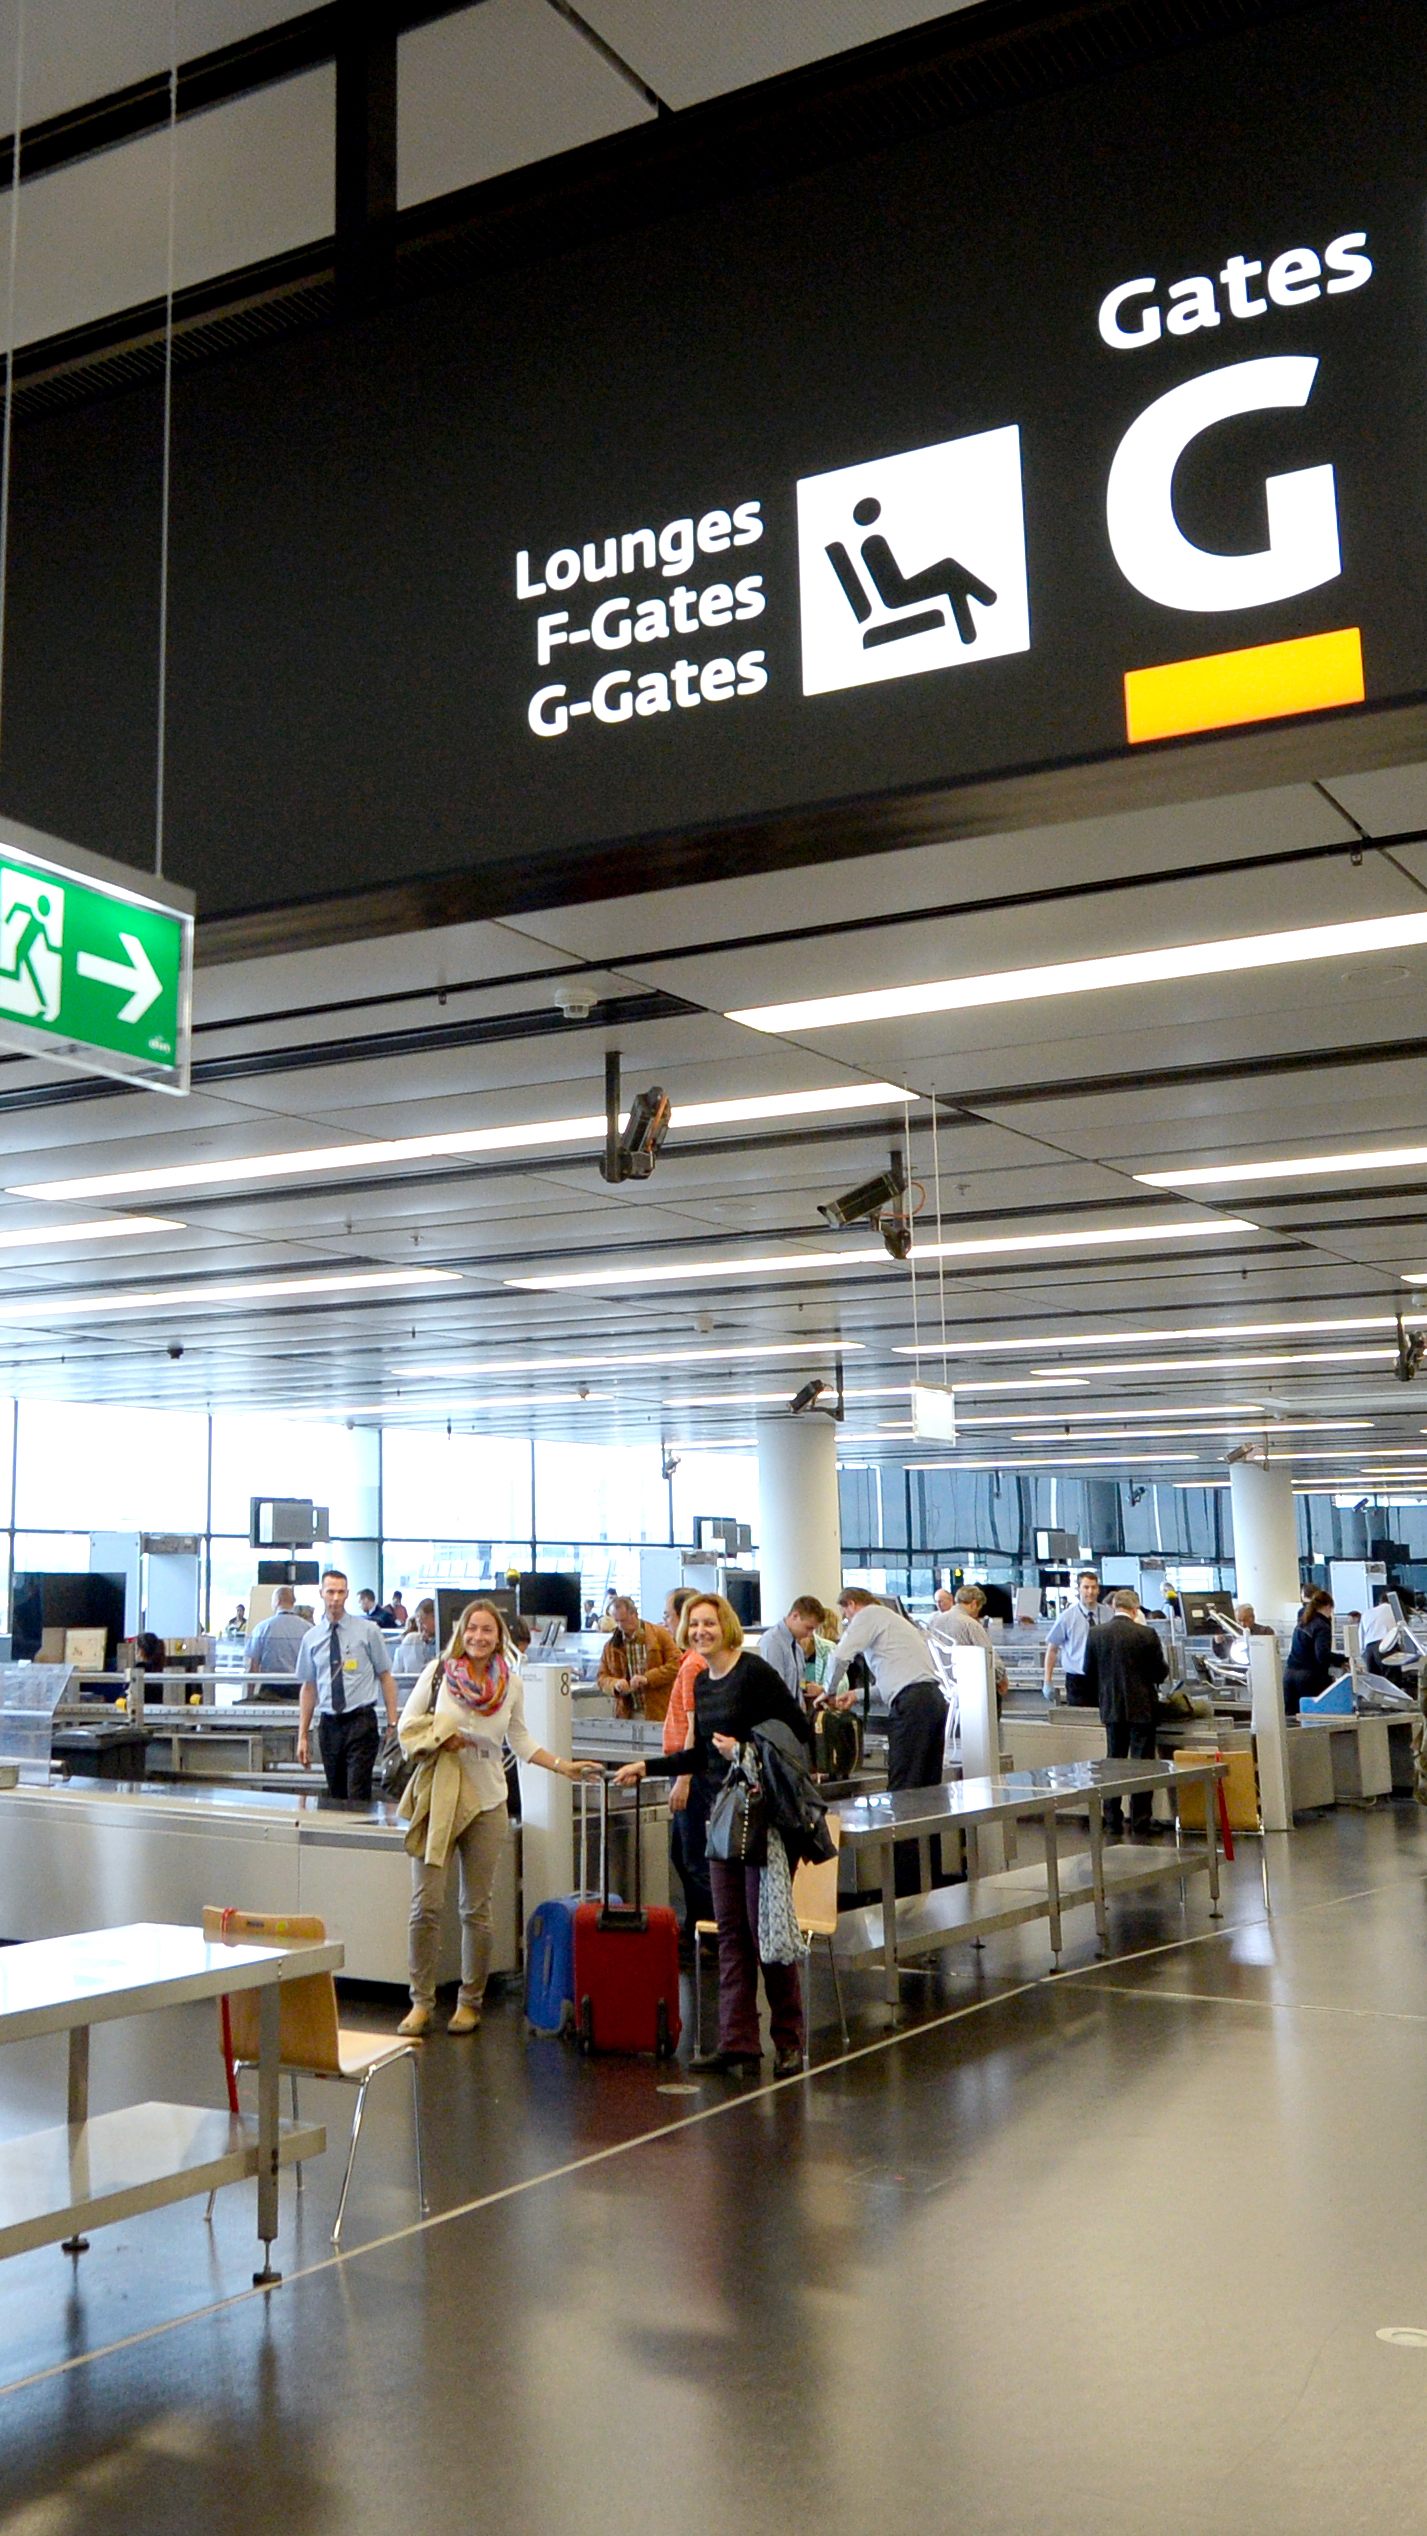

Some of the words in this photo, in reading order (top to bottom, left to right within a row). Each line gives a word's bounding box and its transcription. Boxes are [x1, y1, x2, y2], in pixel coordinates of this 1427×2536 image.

[1098, 233, 1372, 349] Gates
[1106, 356, 1341, 612] G
[516, 501, 763, 600] Lounges
[537, 575, 765, 666] F-Gates
[528, 650, 767, 737] G-Gates
[560, 1672, 570, 1696] 8
